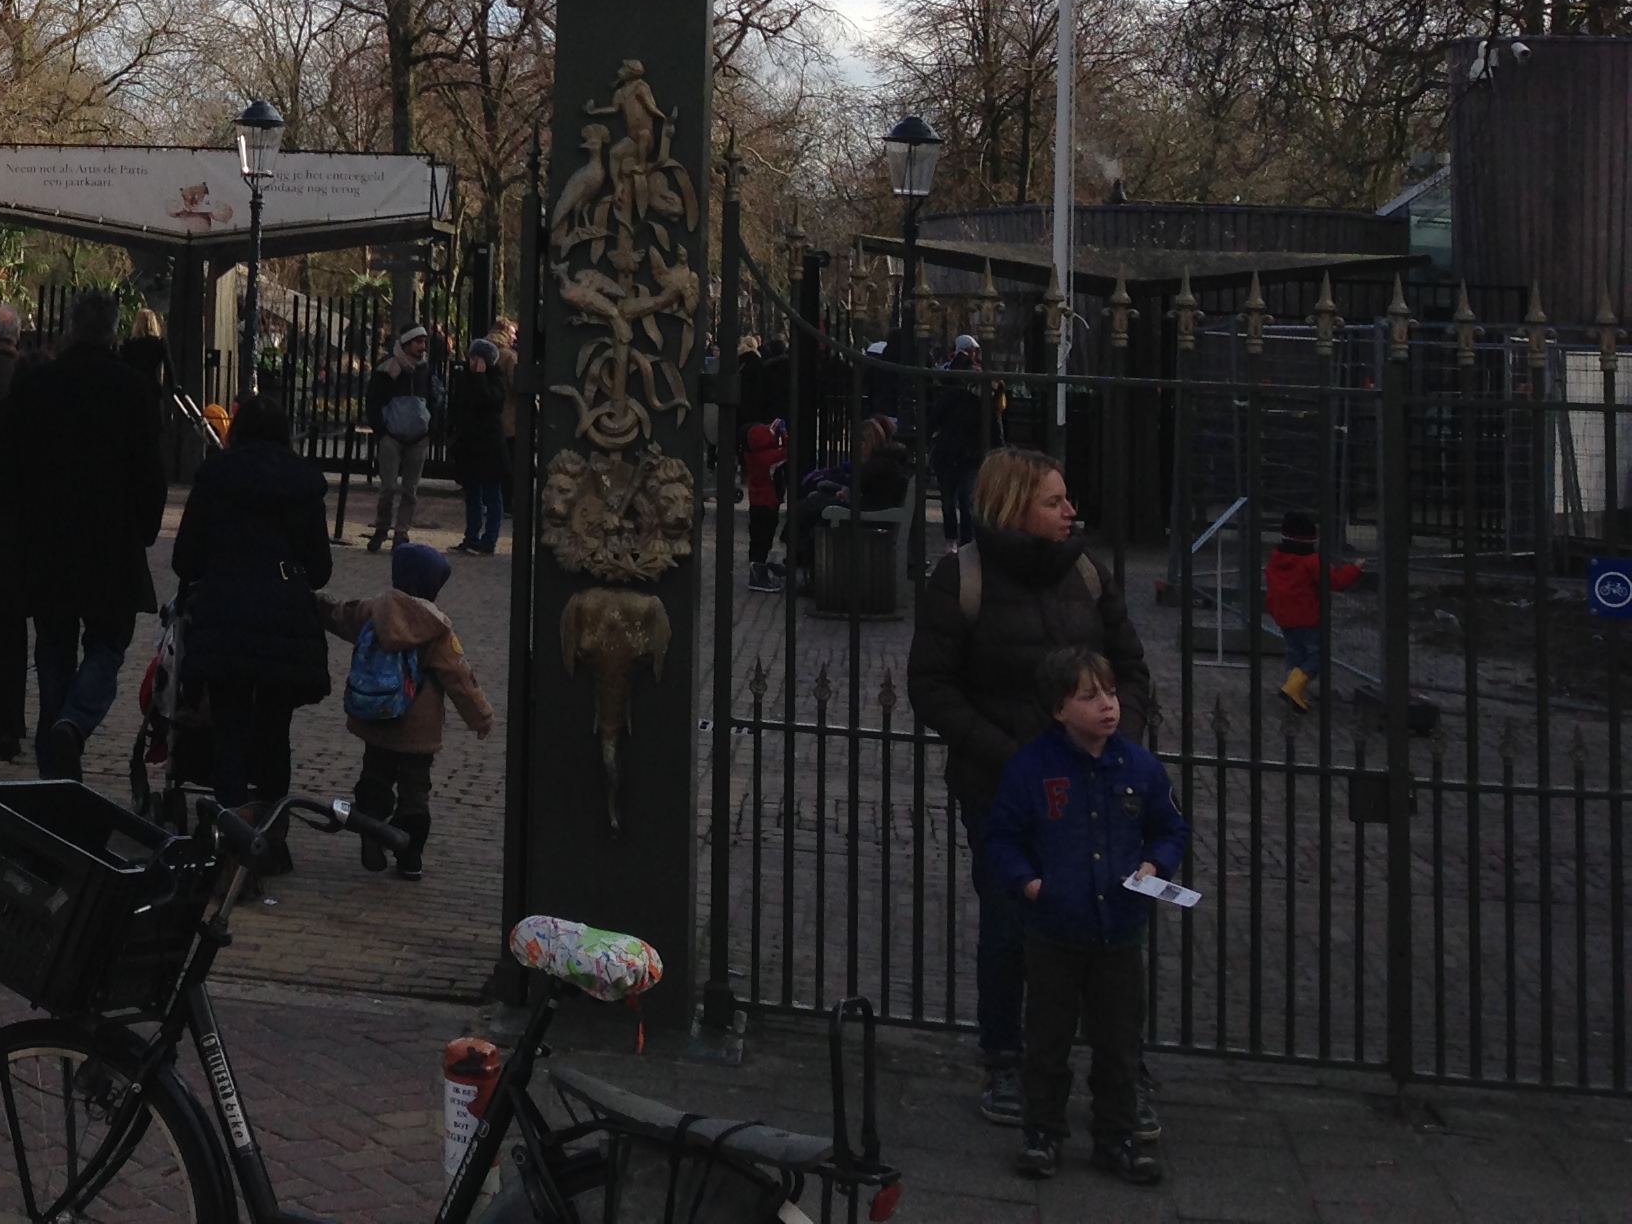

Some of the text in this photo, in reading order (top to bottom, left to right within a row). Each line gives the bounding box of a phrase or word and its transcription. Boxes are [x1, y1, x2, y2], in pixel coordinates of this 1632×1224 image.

[6, 162, 36, 174] Neem
[76, 164, 101, 175] Artis
[103, 164, 117, 175] de
[42, 178, 62, 186] een
[292, 170, 302, 182] je
[305, 169, 323, 180] het
[326, 171, 385, 184] entreegeld
[258, 182, 304, 194] vandaag
[307, 186, 328, 196] nog
[1042, 776, 1071, 821] F
